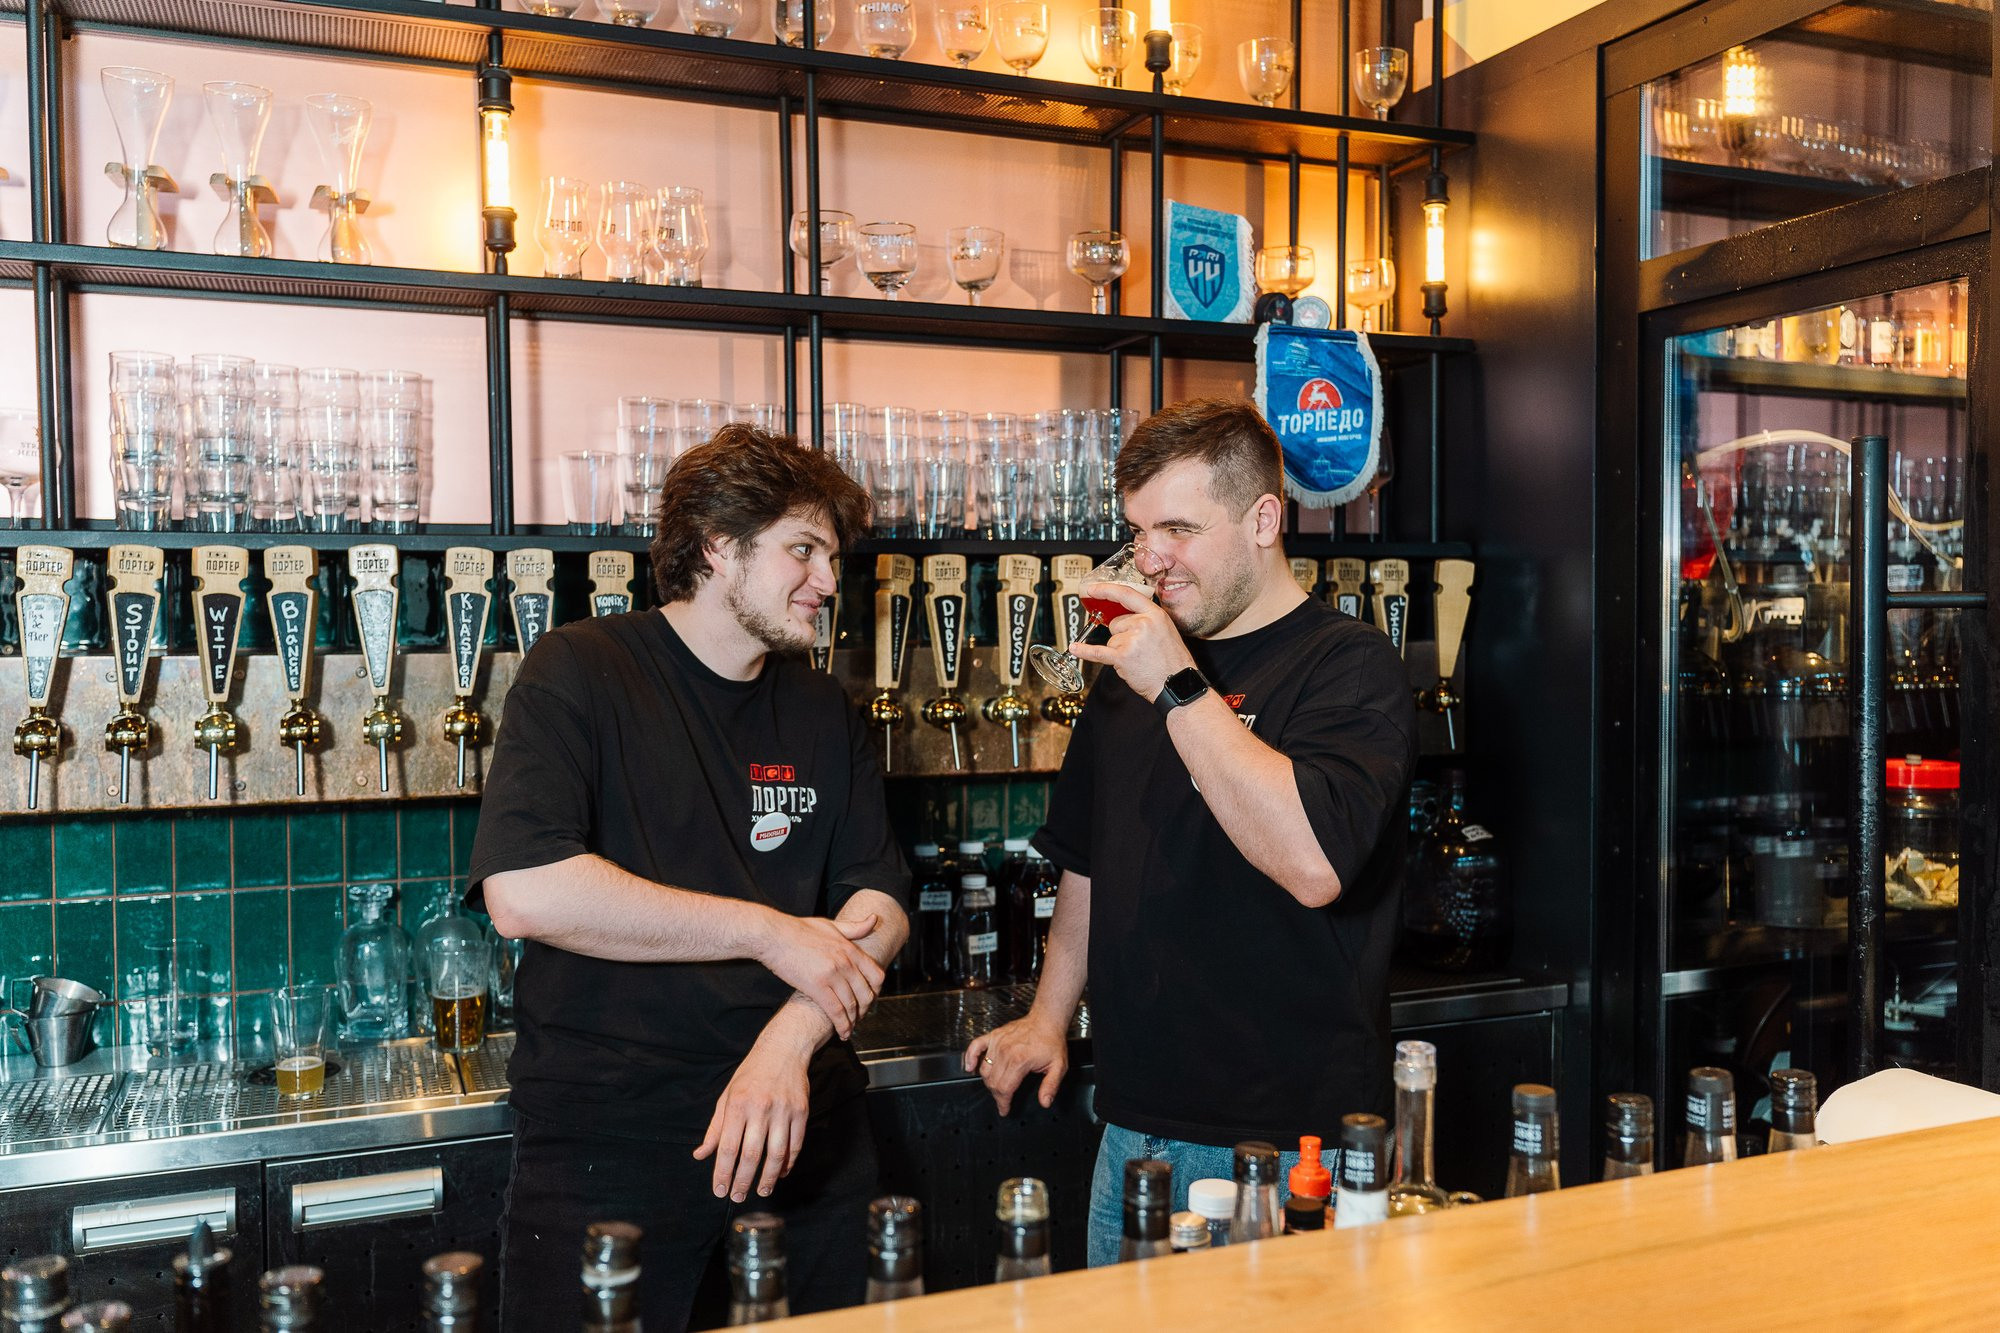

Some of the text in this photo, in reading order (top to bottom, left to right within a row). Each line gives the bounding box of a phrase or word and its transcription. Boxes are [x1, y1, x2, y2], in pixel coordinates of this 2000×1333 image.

[1188, 248, 1220, 261] PARI
[1277, 408, 1364, 436] ТОРПЕДО
[25, 560, 63, 573] ПОРТЕР
[119, 558, 155, 572] ПОРТЕР
[206, 560, 240, 571] ПОРТЕР
[272, 560, 304, 571] ПОРТЕР
[357, 558, 389, 570] ПОРТЕР
[453, 561, 485, 572] ПОРТЕР
[515, 562, 545, 574] ПОРТЕР
[596, 564, 626, 575] ПОРТЕР
[935, 567, 960, 578] ПОРТЕР
[523, 596, 540, 643] IP
[209, 606, 228, 680] WITE
[751, 785, 817, 813] ПОРТЕР
